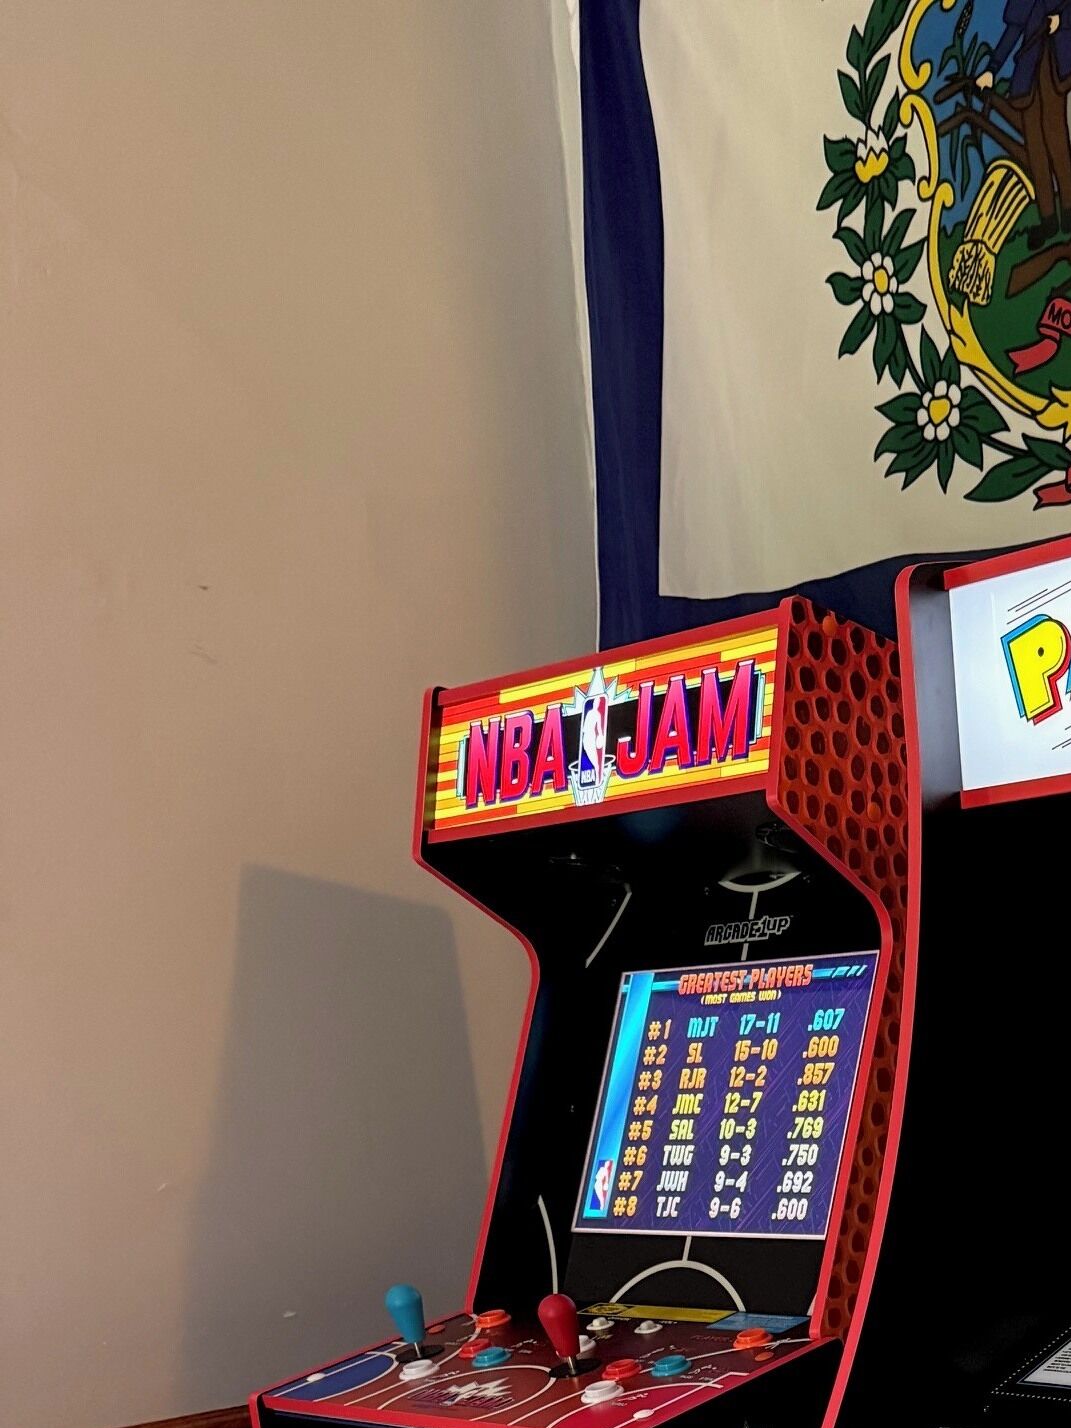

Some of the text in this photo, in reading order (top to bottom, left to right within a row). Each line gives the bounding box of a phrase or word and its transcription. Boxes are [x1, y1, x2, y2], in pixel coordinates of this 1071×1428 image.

[464, 659, 756, 809] NBA JAM
[581, 769, 595, 783] NBA
[678, 964, 814, 995] GREATEST PLAYERS
[730, 992, 756, 1003] GAMES
[648, 1008, 845, 1040] #1 MJT 17-11 .607
[643, 1036, 840, 1065] #2 SL 15-10 .600
[638, 1062, 835, 1090] #3 RJR 12-2 .857
[633, 1090, 827, 1115] #4 JMC 12-7 .631
[628, 1117, 824, 1141] #5 SAL 10-3 .769
[623, 1144, 819, 1167] #6 TWG 9-3 .750
[618, 1170, 814, 1193] #7 JWH 9-4 .692
[613, 1196, 808, 1220] #8 TJC 9-6 .600
